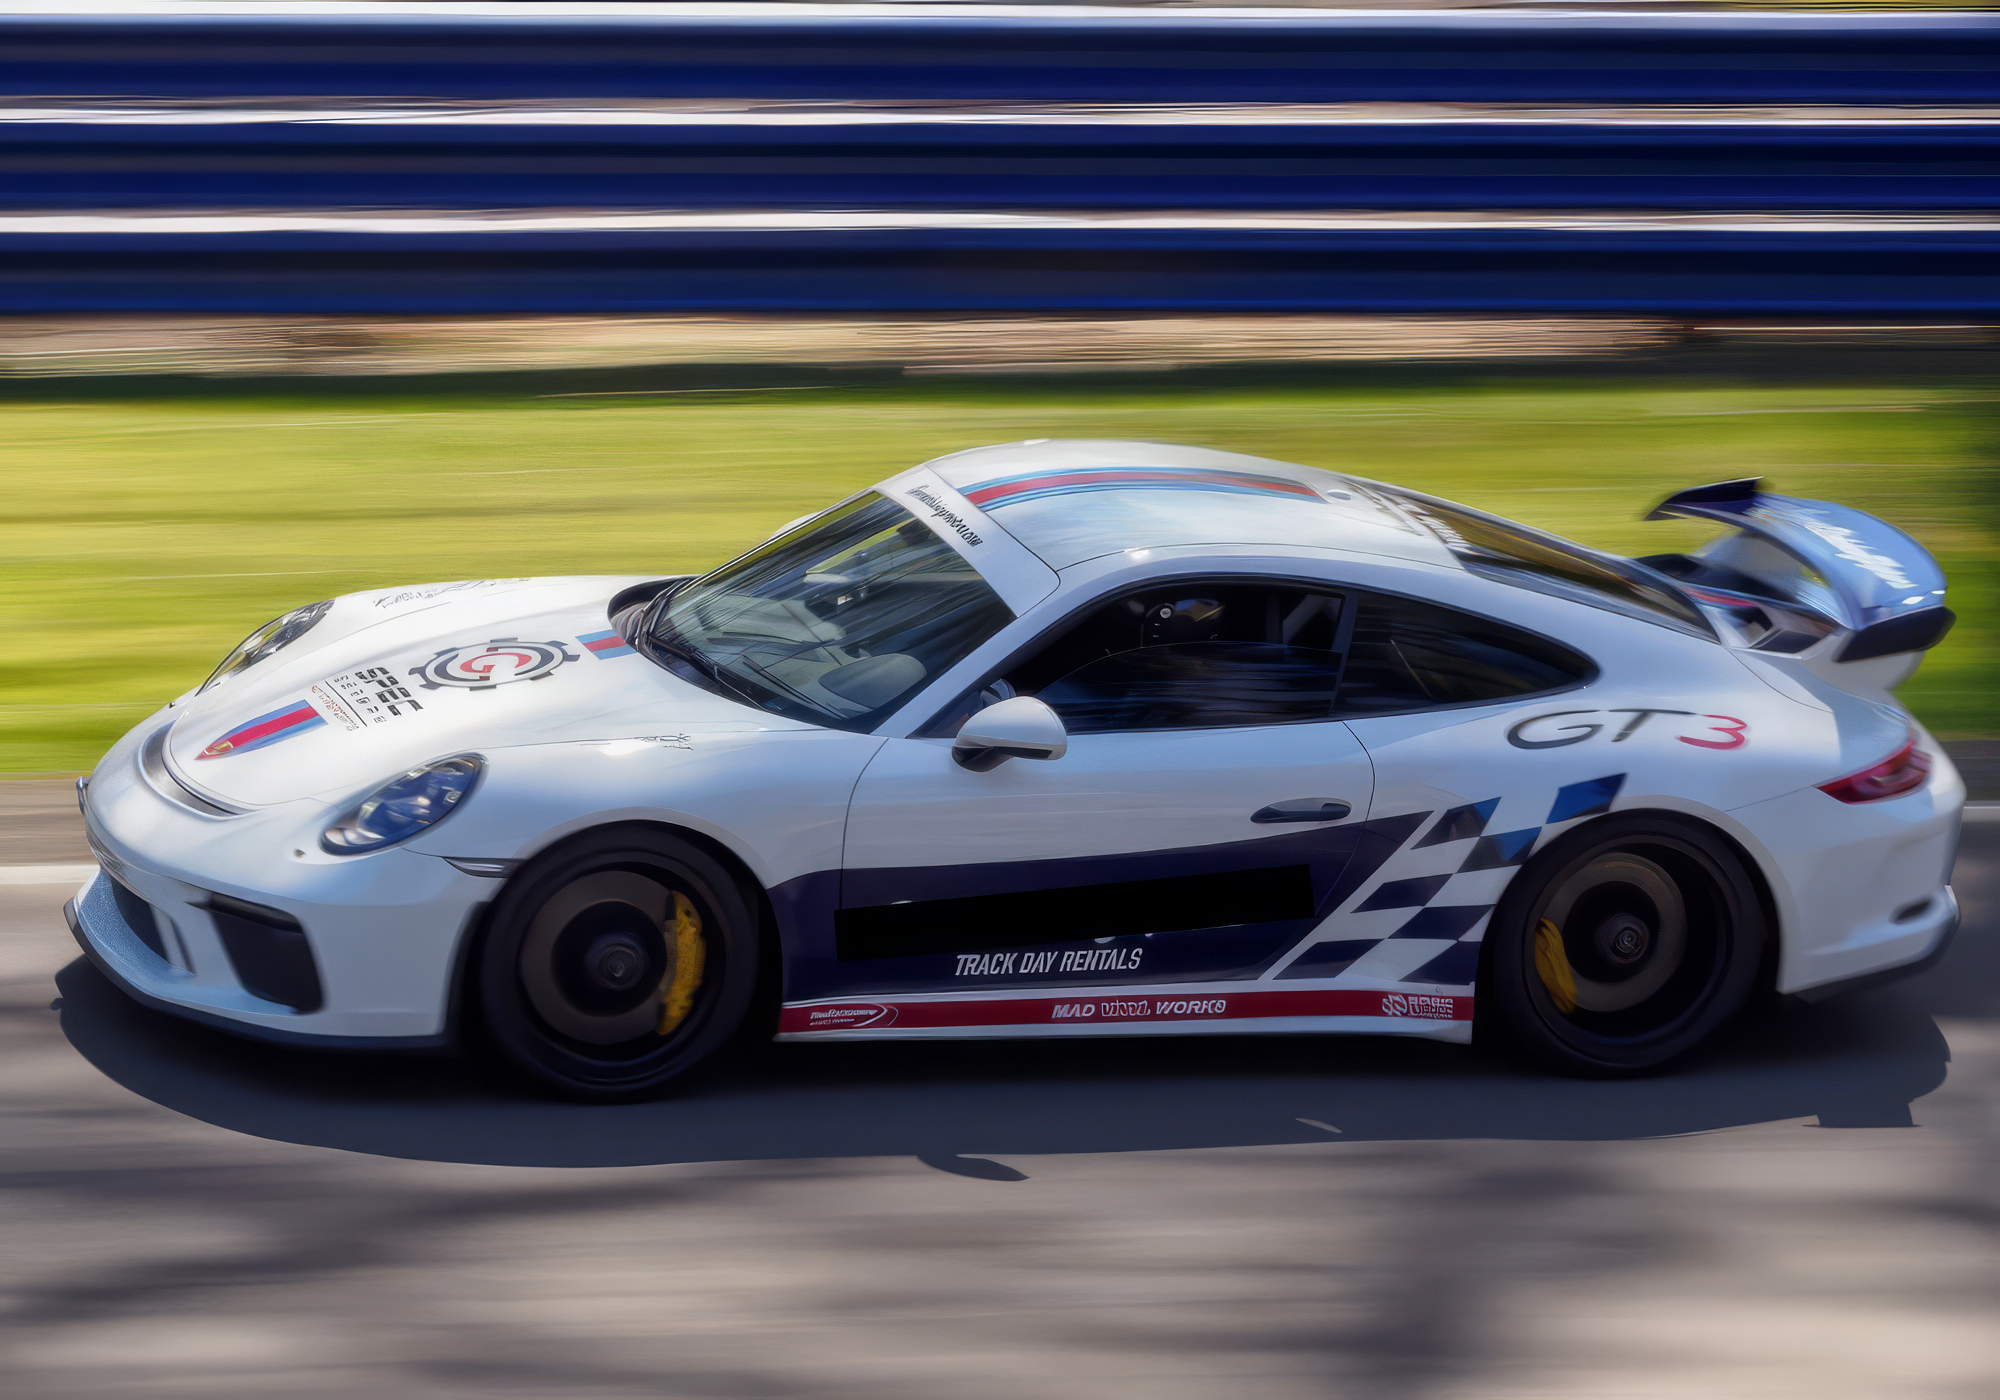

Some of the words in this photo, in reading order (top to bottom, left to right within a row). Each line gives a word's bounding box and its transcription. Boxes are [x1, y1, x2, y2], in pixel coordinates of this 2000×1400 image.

[1506, 708, 1748, 750] GT3
[954, 952, 1019, 976] TRACK
[1018, 951, 1059, 974] DAY
[1058, 947, 1143, 972] RENTALS
[1051, 1003, 1096, 1019] MAD
